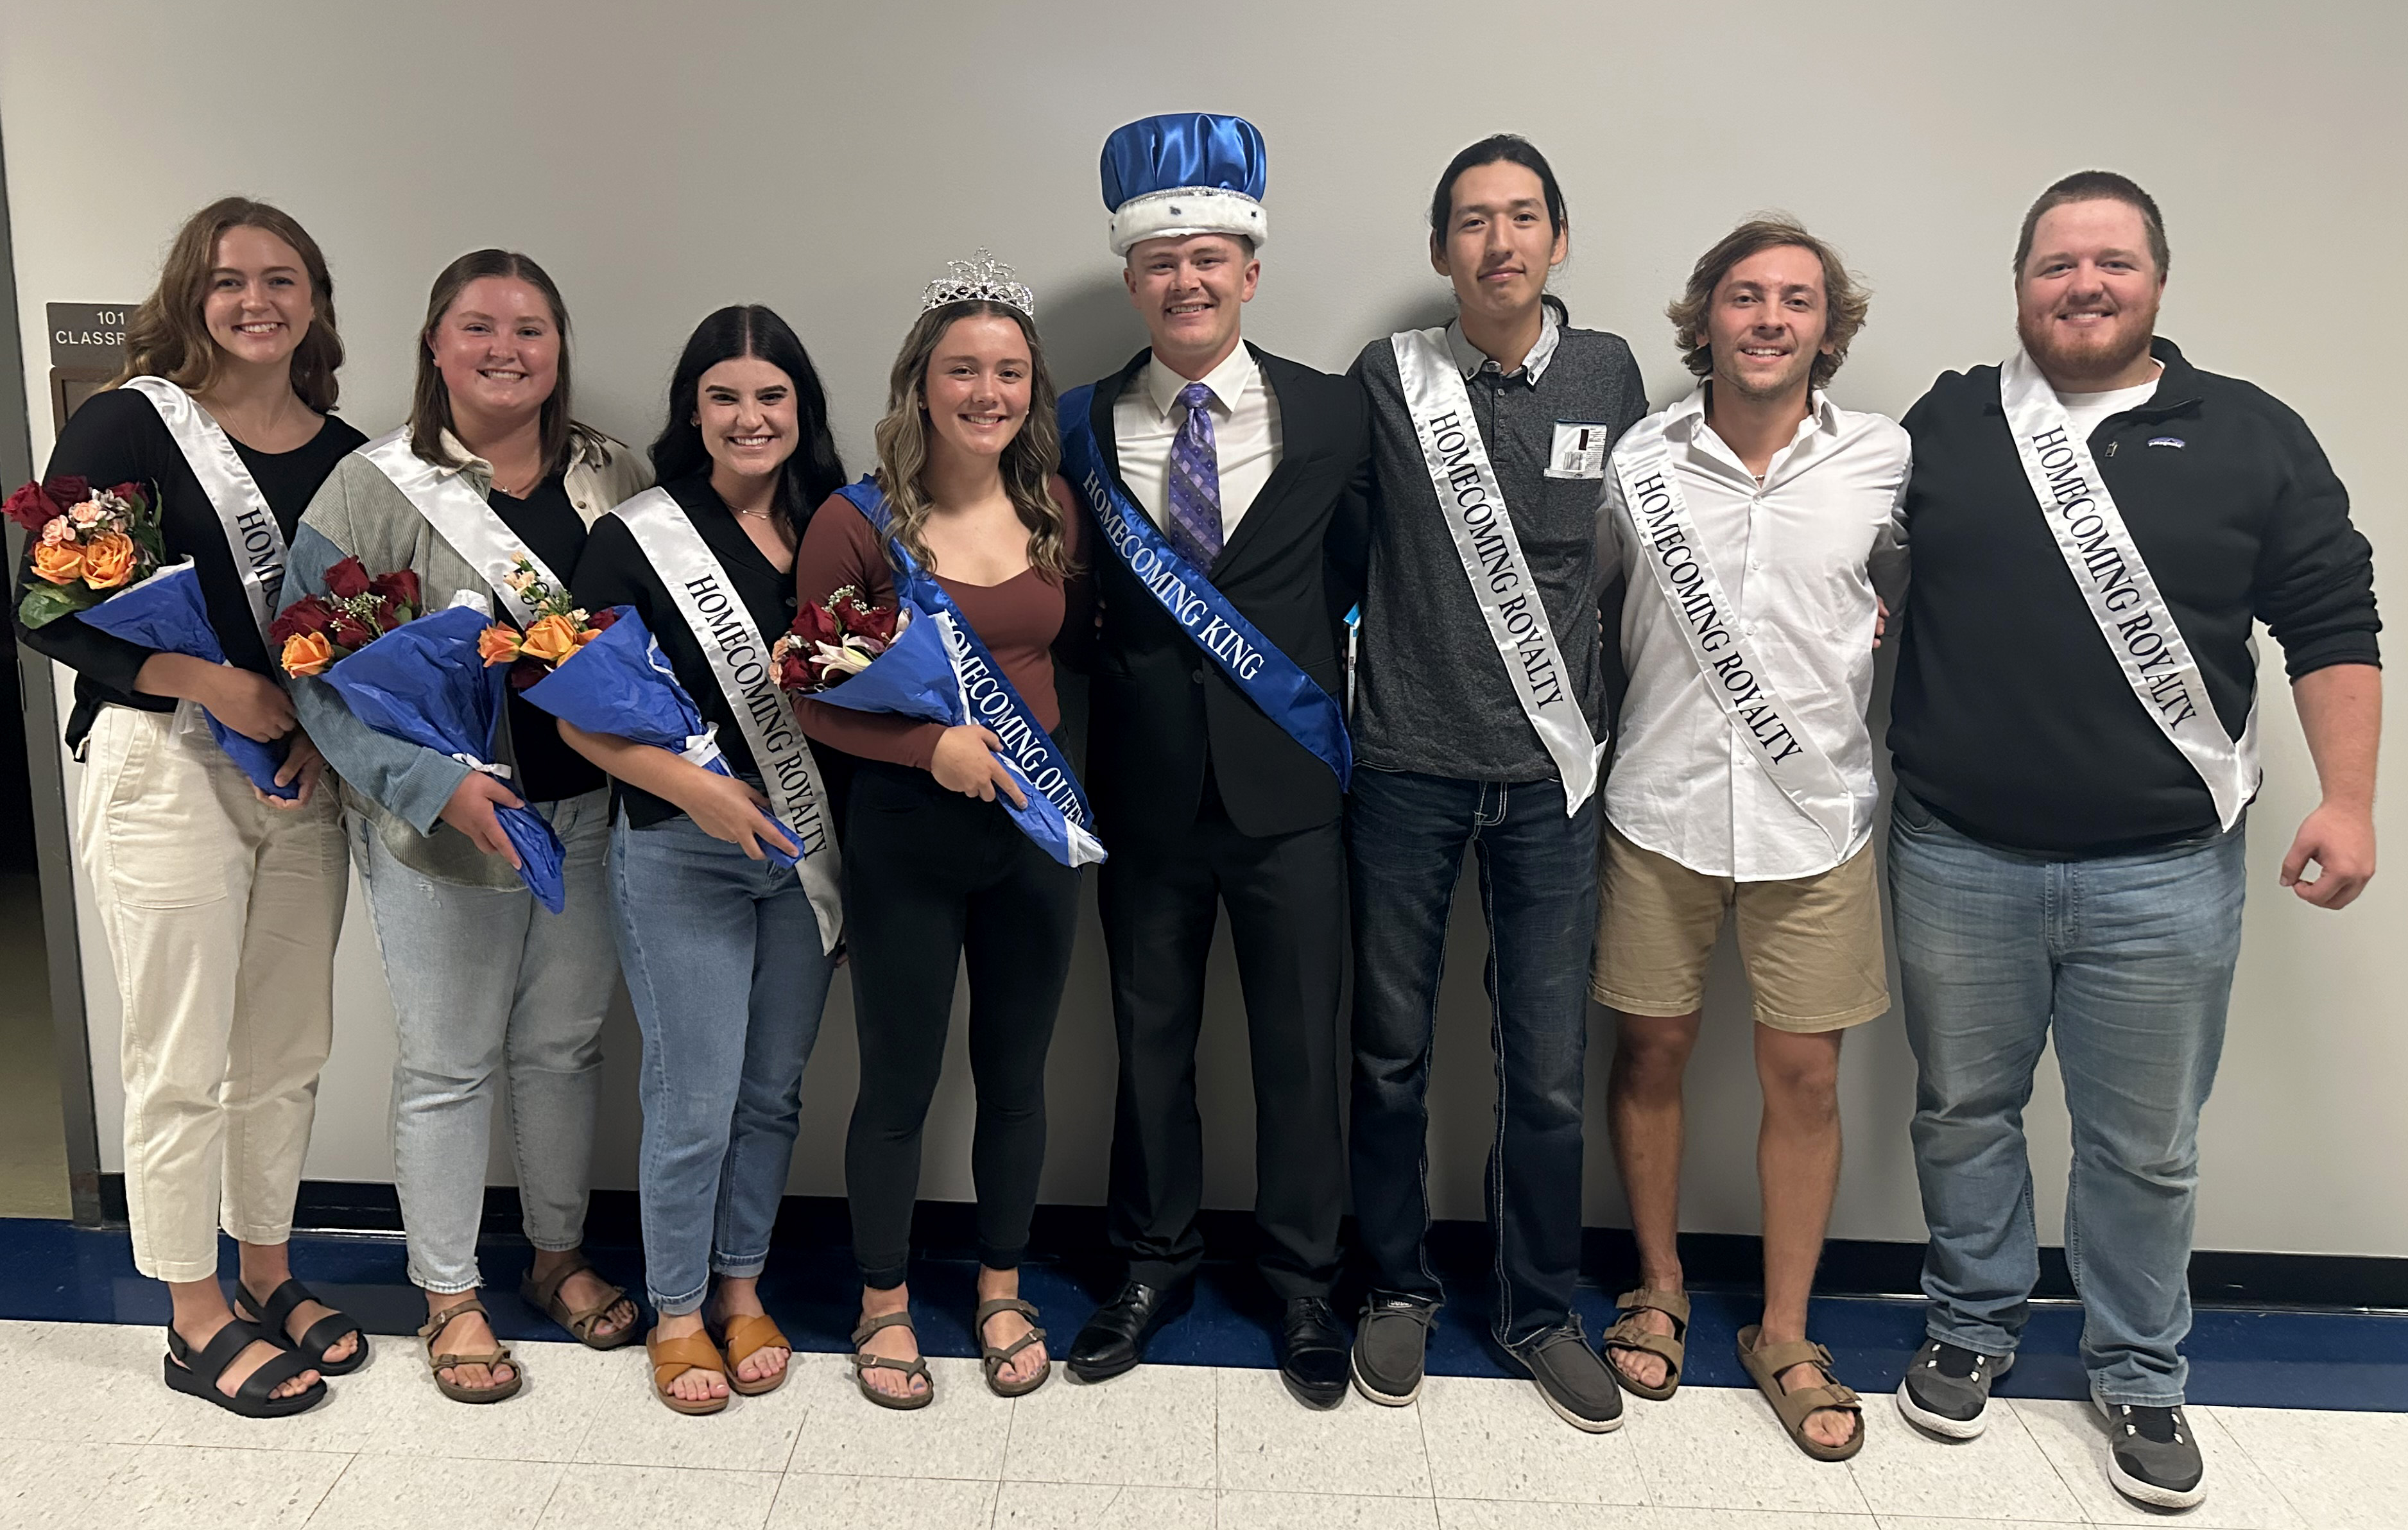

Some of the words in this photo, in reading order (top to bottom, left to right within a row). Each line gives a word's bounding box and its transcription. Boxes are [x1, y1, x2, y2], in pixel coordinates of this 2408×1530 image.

[96, 311, 125, 325] 101
[944, 608, 1048, 771] OMECOMING
[1083, 467, 1208, 626] HOMECOMING
[1198, 614, 1264, 680] KING
[1429, 409, 1518, 594] HOMECOMING
[1499, 592, 1563, 710] ROYALTY
[1635, 471, 1730, 652] HOMECOMING
[1712, 651, 1803, 765] ROYALTY
[2032, 424, 2140, 612] HOMECOMING
[2117, 610, 2196, 731] ROYALTY
[685, 574, 795, 753] HOMECOMING
[774, 751, 827, 861] ROYALTY
